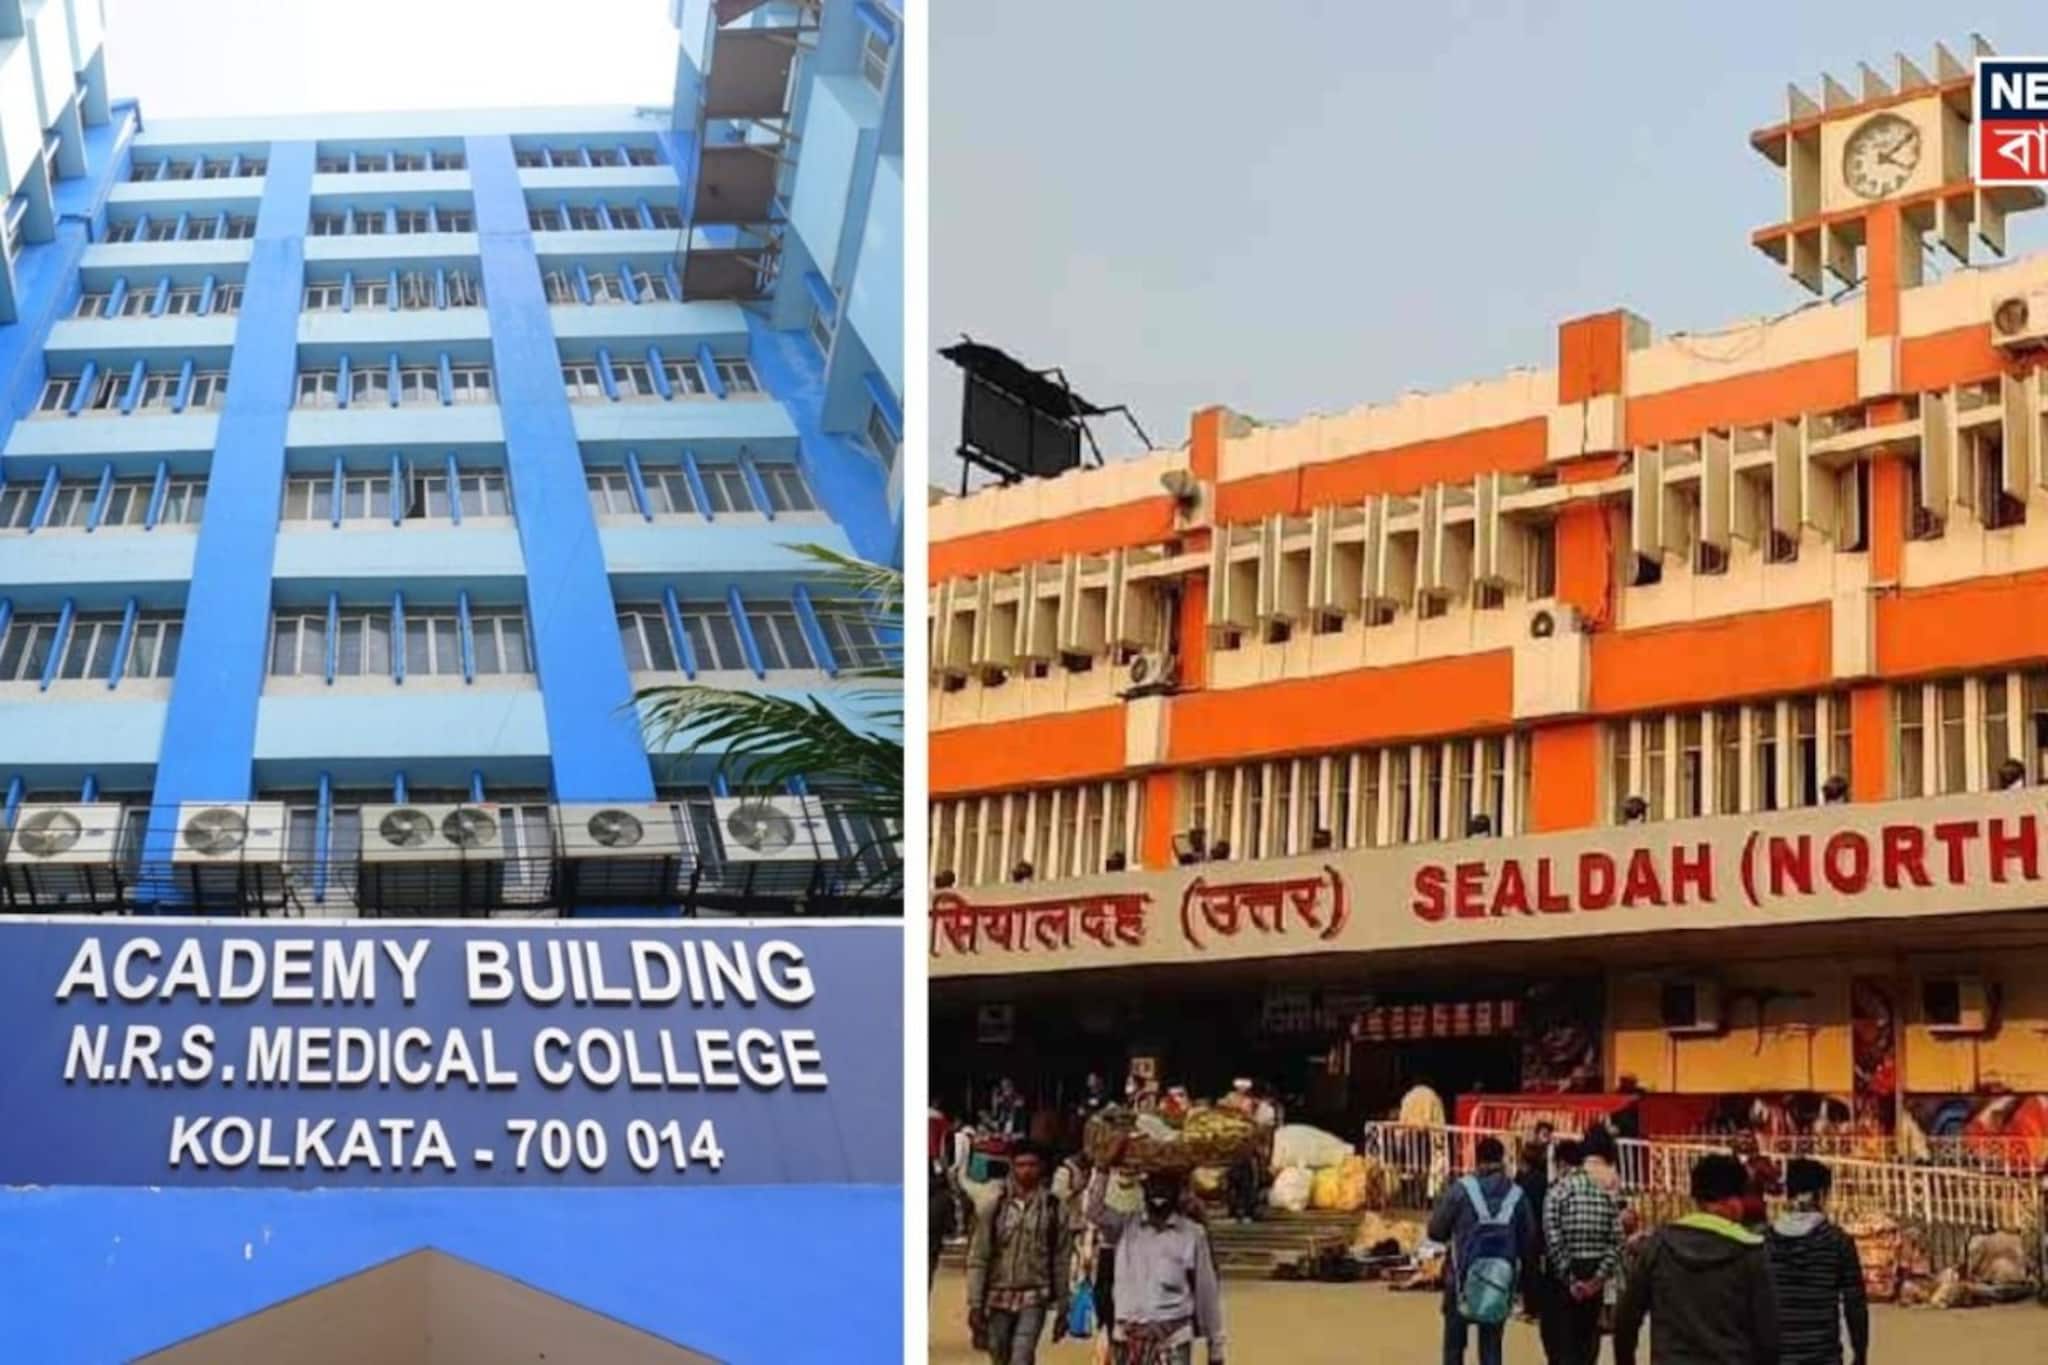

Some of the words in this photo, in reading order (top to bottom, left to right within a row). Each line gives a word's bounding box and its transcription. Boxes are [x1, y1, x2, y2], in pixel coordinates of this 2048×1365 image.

[929, 892, 1152, 957] सियालदह
[1180, 866, 1345, 946] (उत्तर)
[1412, 844, 1714, 921] SEALDAH
[56, 937, 430, 1004] ACADEMY
[465, 939, 816, 1005] BUILDING
[246, 1025, 518, 1088] MEDICAL
[532, 1028, 829, 1089] COLLEGE
[168, 1115, 457, 1170] KOLKATA
[505, 1119, 608, 1171] 700
[626, 1120, 725, 1171] 014
